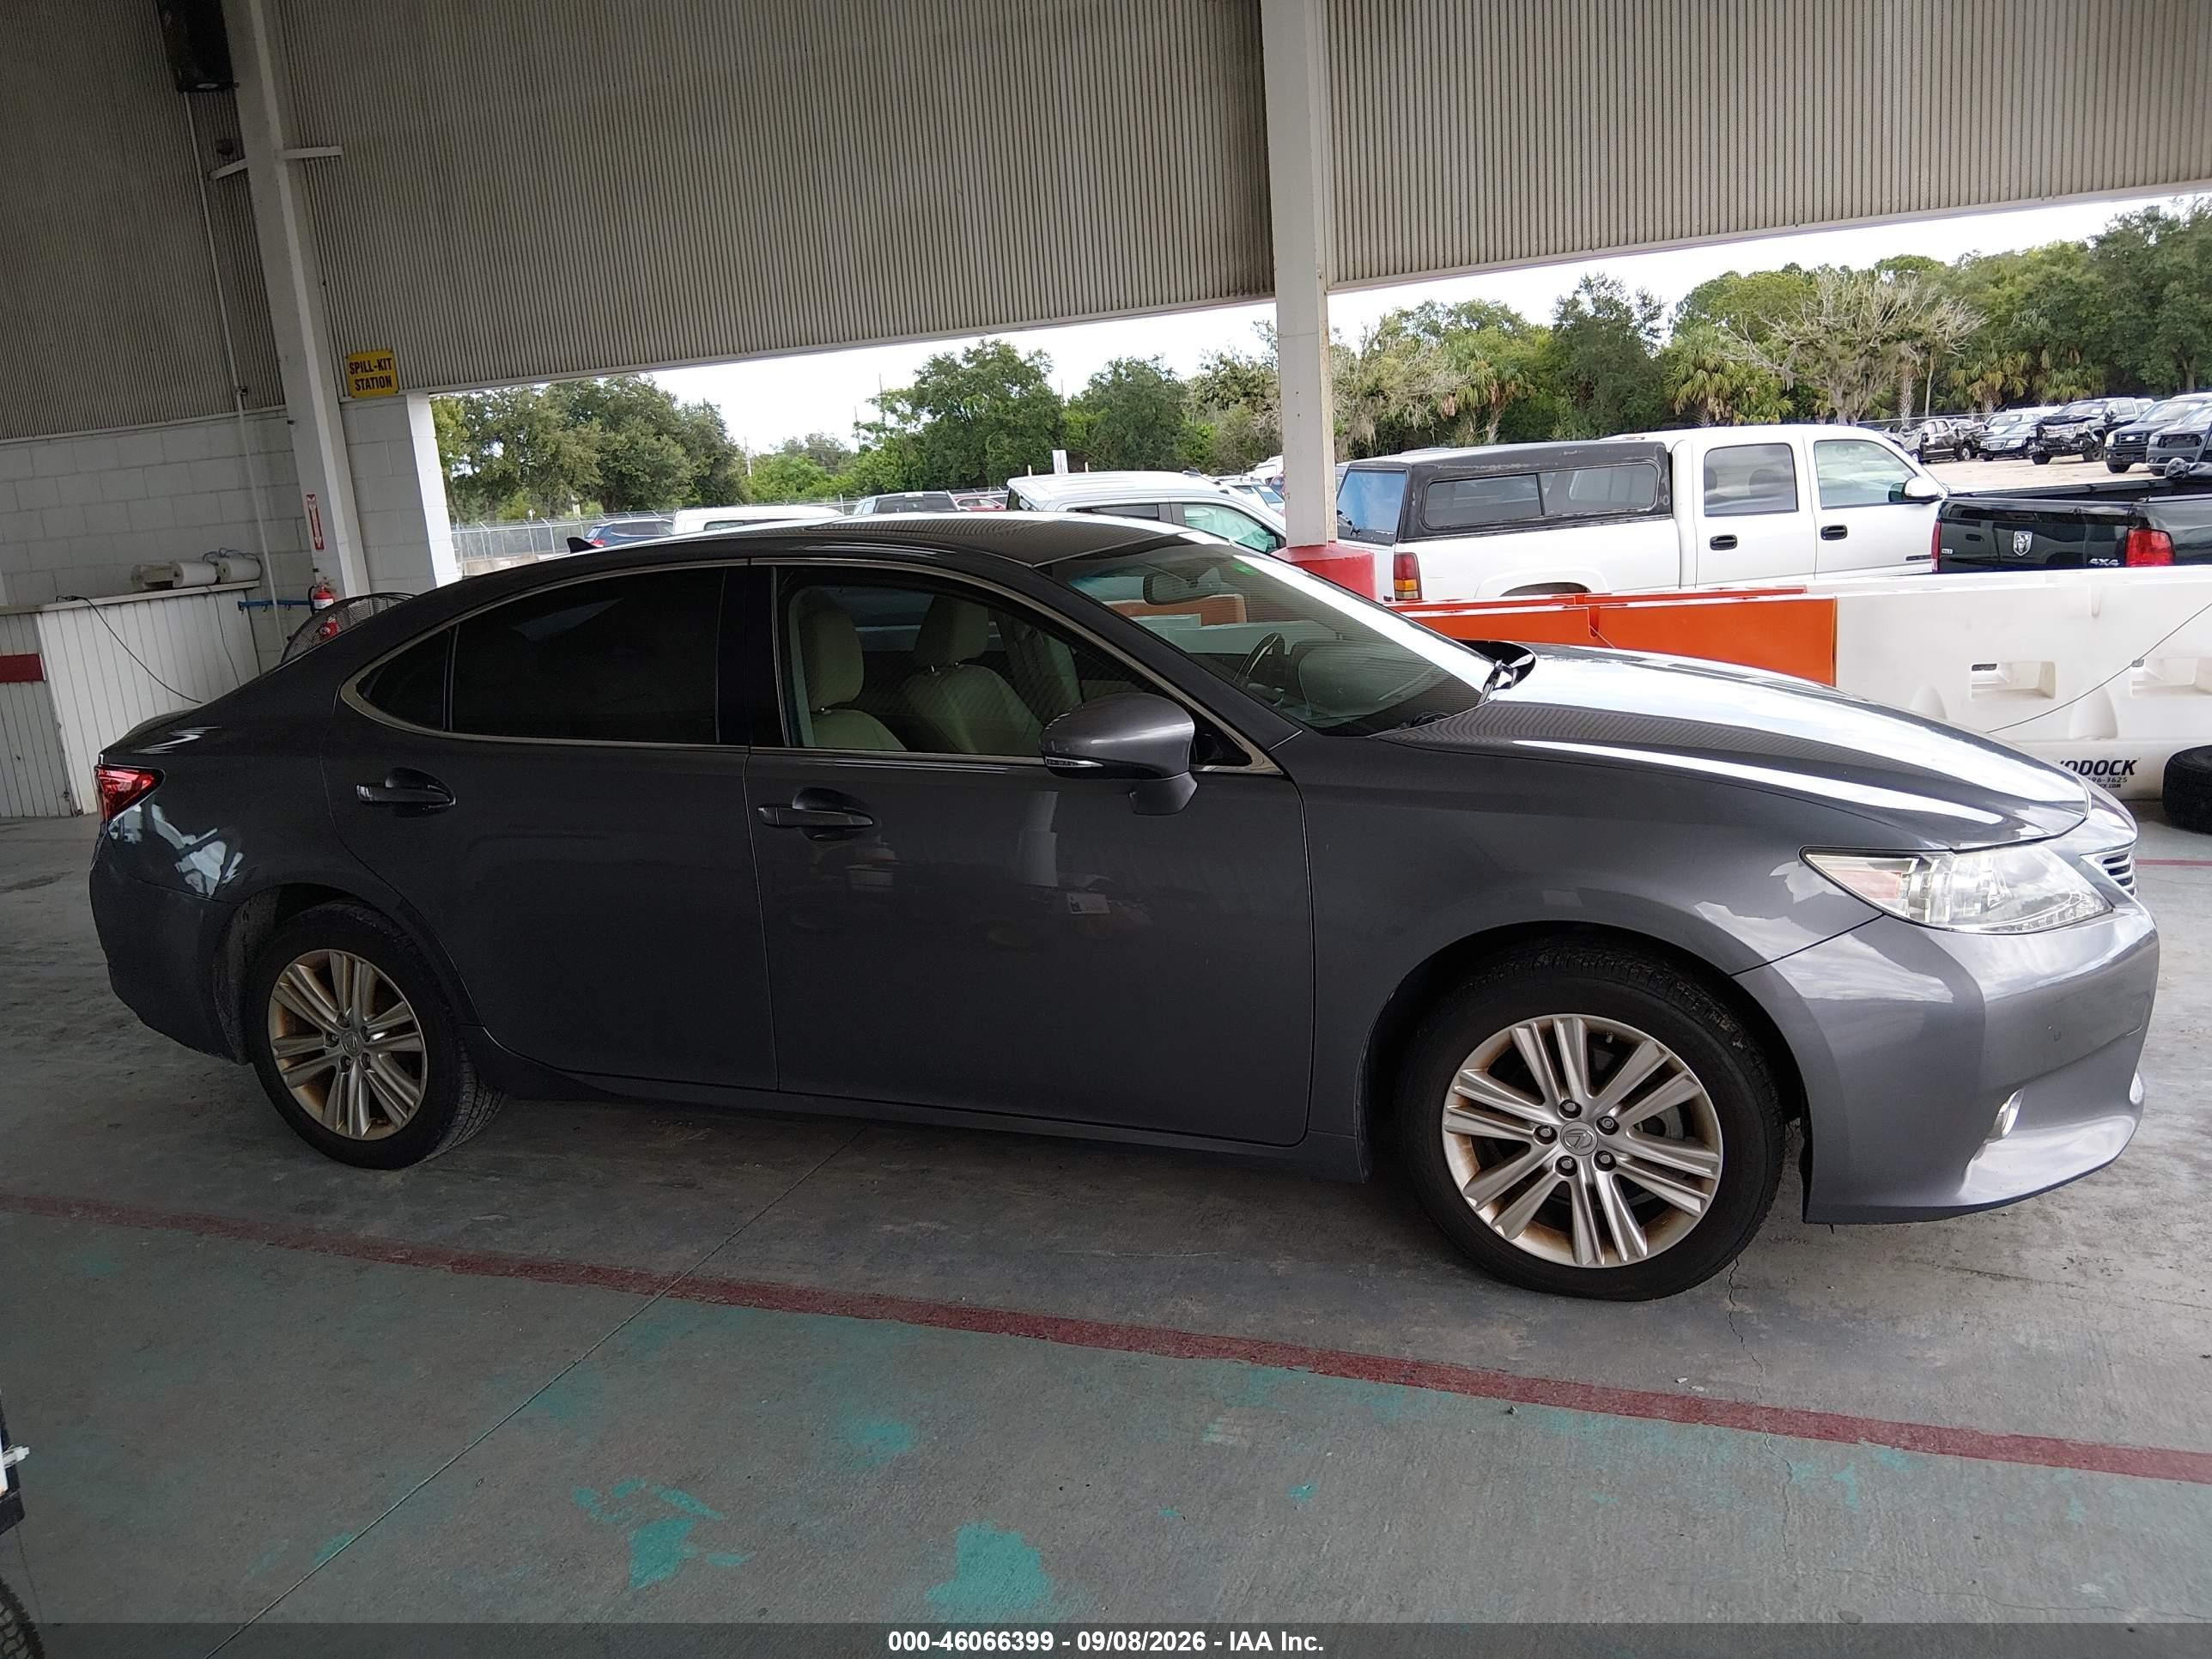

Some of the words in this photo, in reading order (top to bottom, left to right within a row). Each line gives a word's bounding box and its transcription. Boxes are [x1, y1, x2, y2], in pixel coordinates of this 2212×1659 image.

[349, 357, 392, 374] SPILL-KIT
[355, 375, 392, 391] STATION
[2060, 759, 2137, 776] ODOCK
